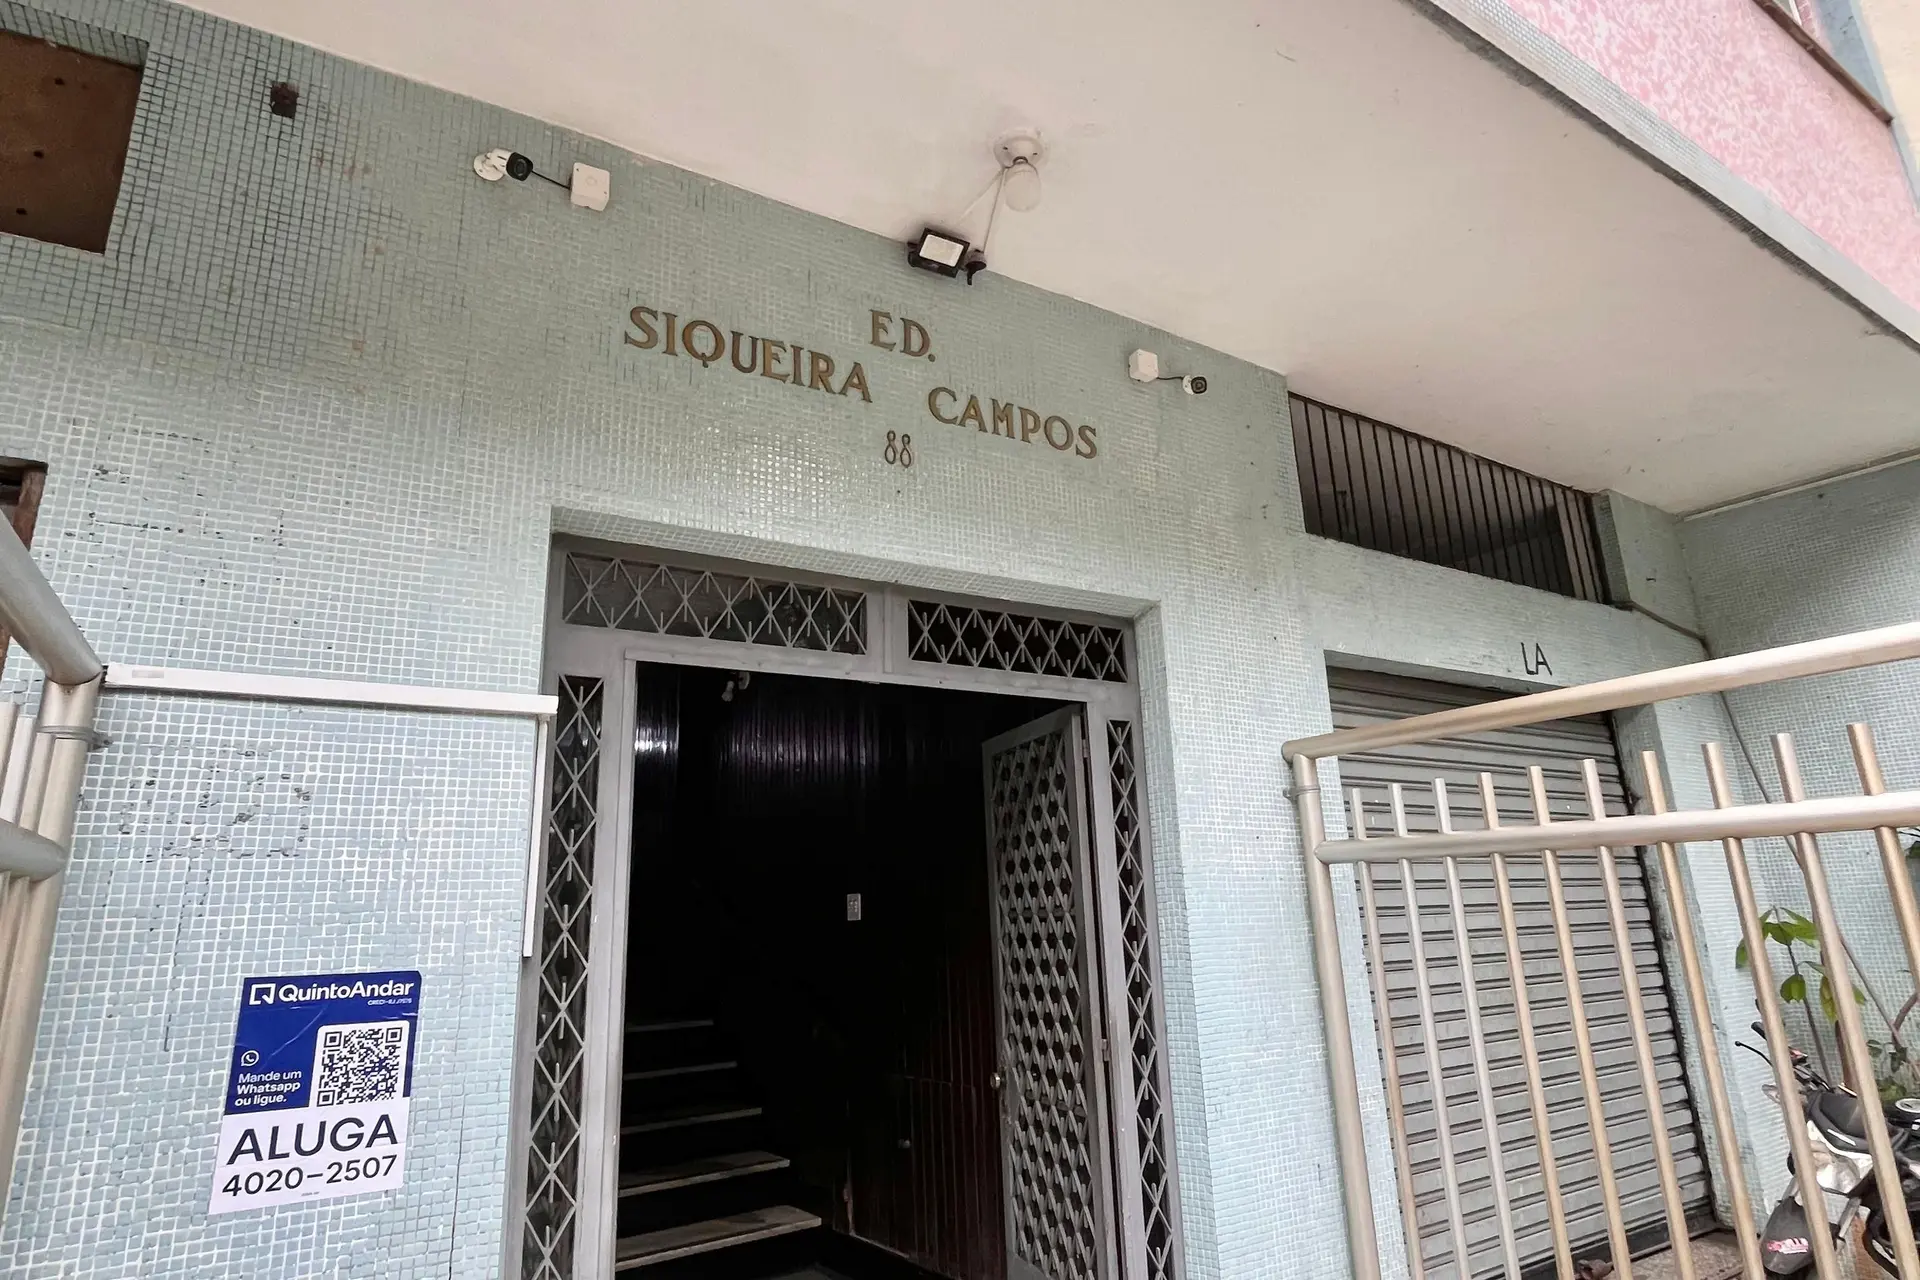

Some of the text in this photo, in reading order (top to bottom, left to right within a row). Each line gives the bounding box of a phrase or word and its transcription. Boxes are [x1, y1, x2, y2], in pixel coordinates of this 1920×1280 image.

[869, 309, 936, 362] ED.
[624, 305, 1098, 460] SIQUEIRA CAMPOS
[884, 429, 913, 468] 88
[278, 979, 414, 1003] QuintoAndar
[237, 1082, 301, 1095] Whatsapp
[238, 1070, 302, 1083] Mande um
[234, 1094, 287, 1106] ou ligue.
[226, 1113, 399, 1166] ALUGA
[221, 1154, 398, 1197] 4020-2507
